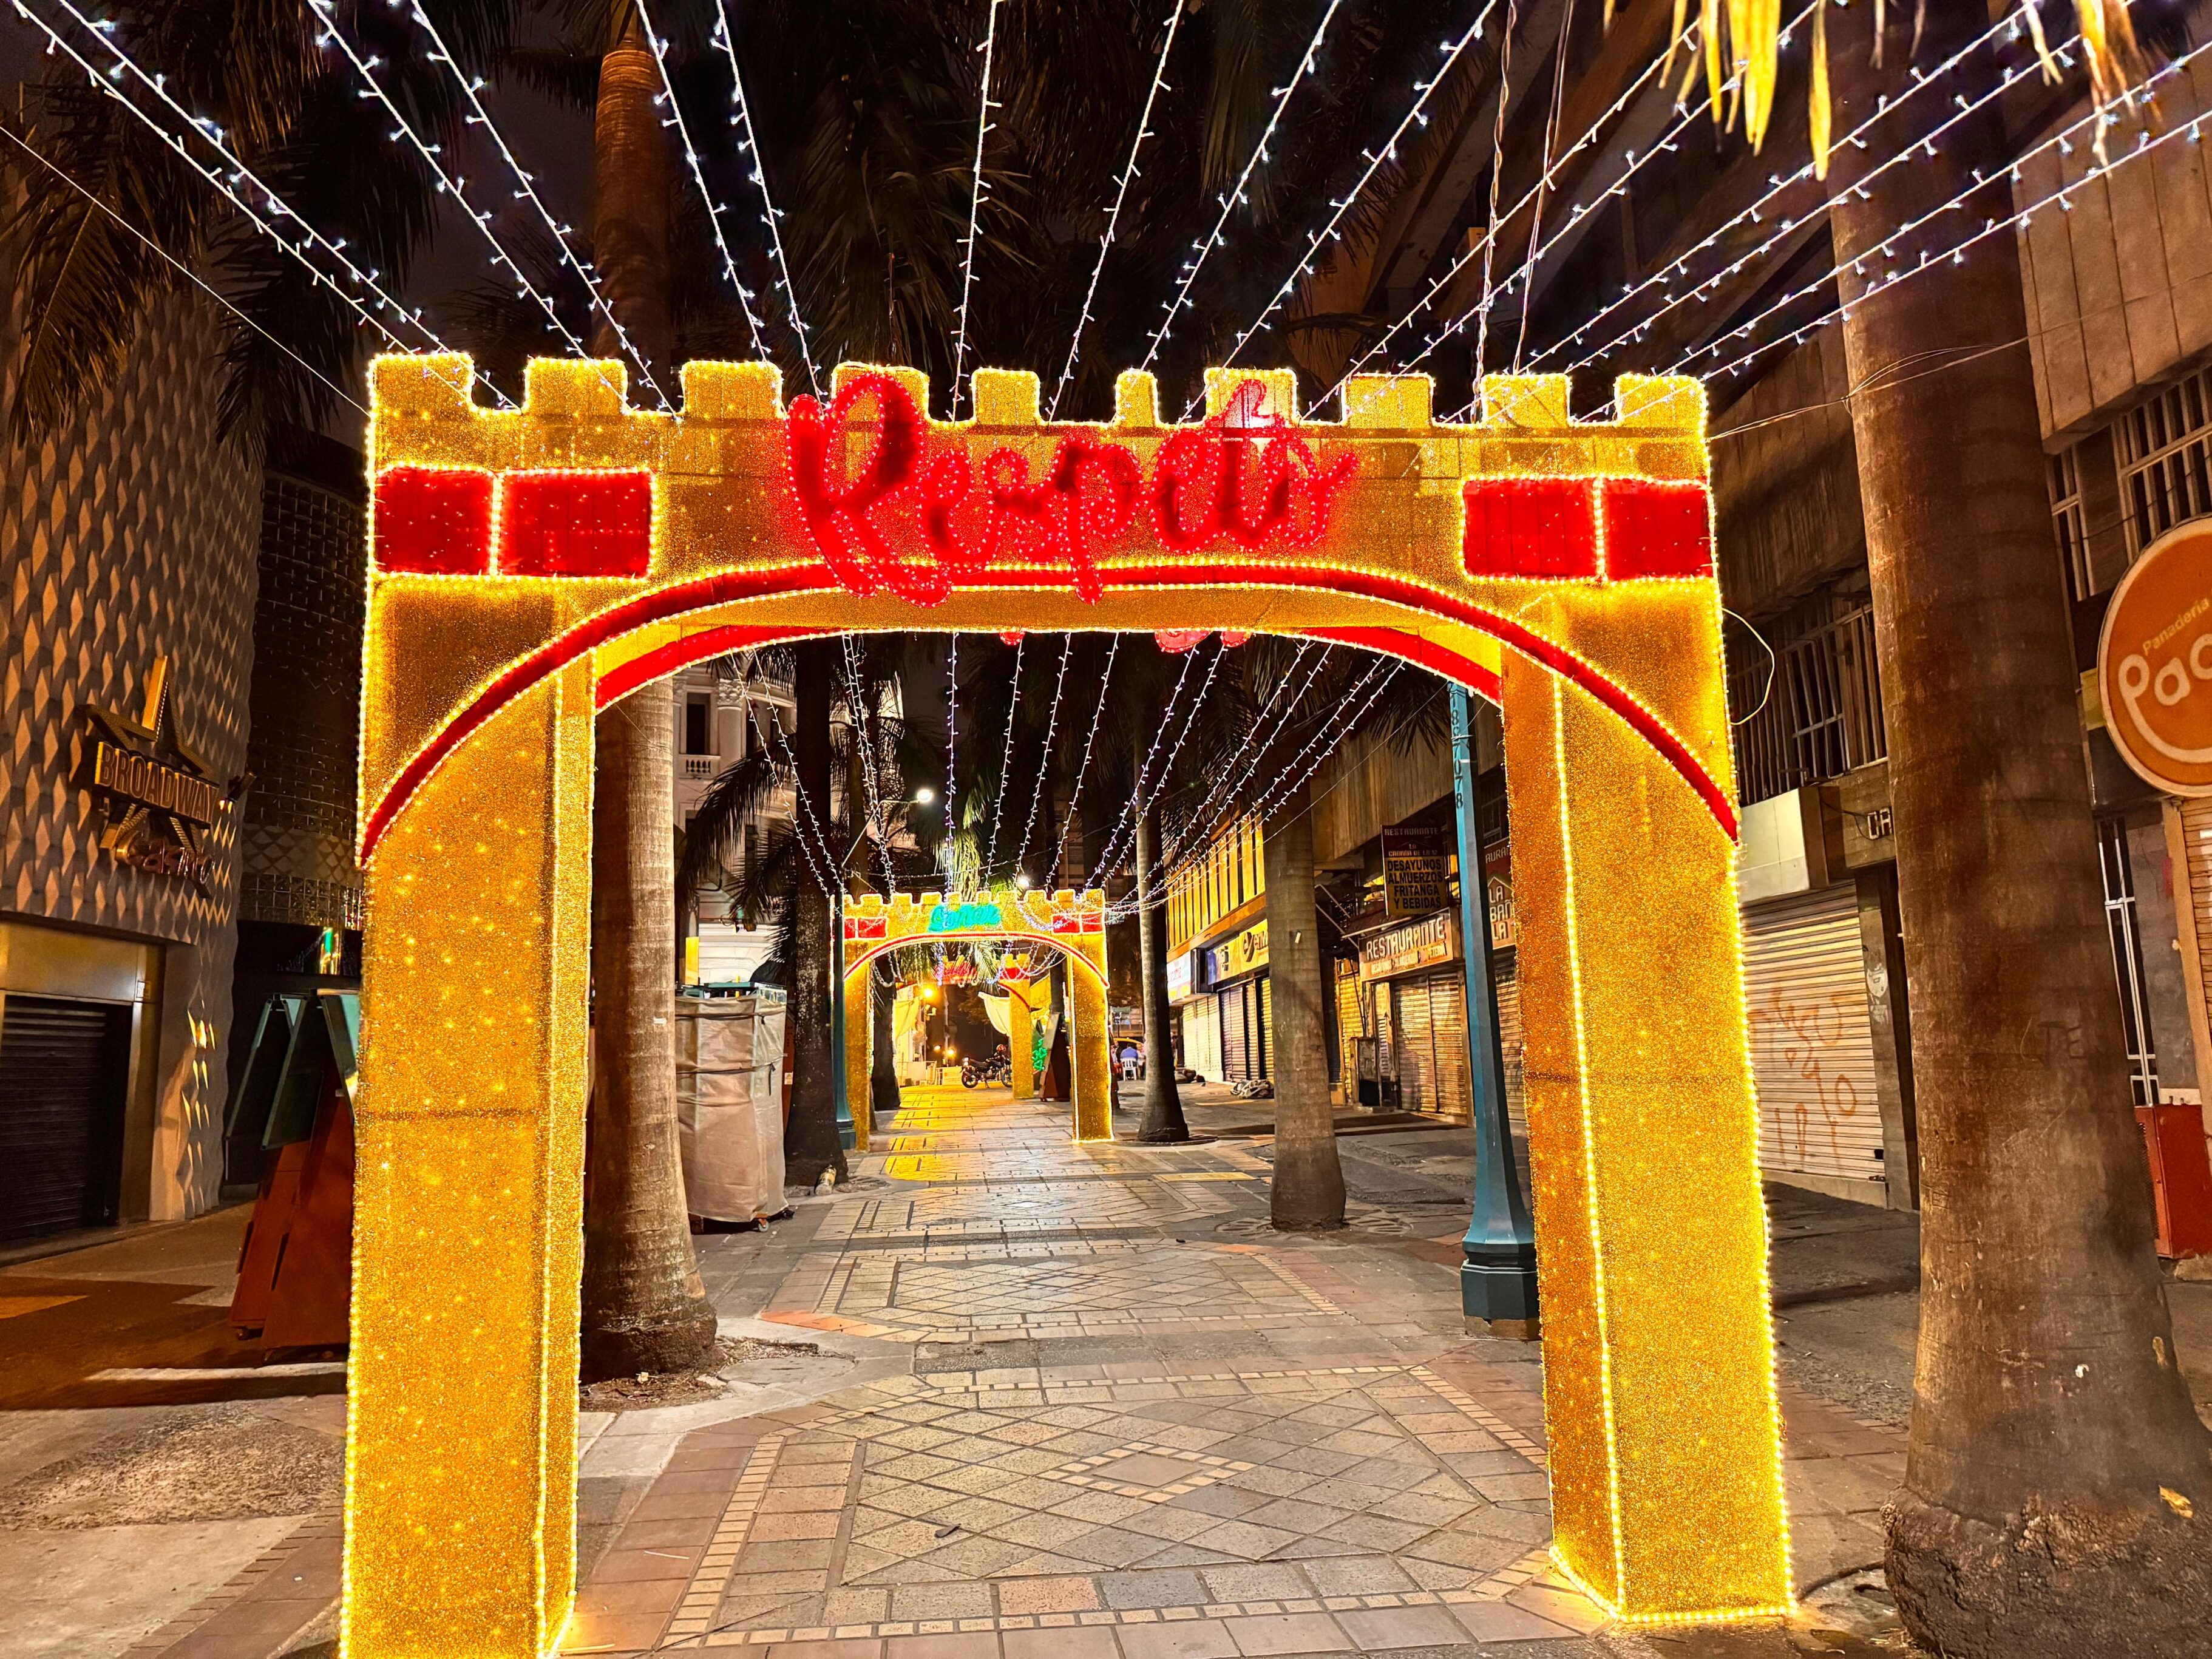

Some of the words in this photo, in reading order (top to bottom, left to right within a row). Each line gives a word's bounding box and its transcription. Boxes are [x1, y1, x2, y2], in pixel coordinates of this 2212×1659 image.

[95, 741, 219, 824] BROADWAY
[1387, 859, 1442, 871] DESAYUNOS
[1388, 872, 1444, 884] ALMUERZOS
[1394, 884, 1440, 897] FRITANGA
[1489, 886, 1504, 903] LA
[1394, 897, 1400, 909] Y
[1403, 897, 1441, 909] BEBIDAS
[1366, 915, 1446, 961] RESTAURANTE
[1492, 922, 1508, 940] LA
